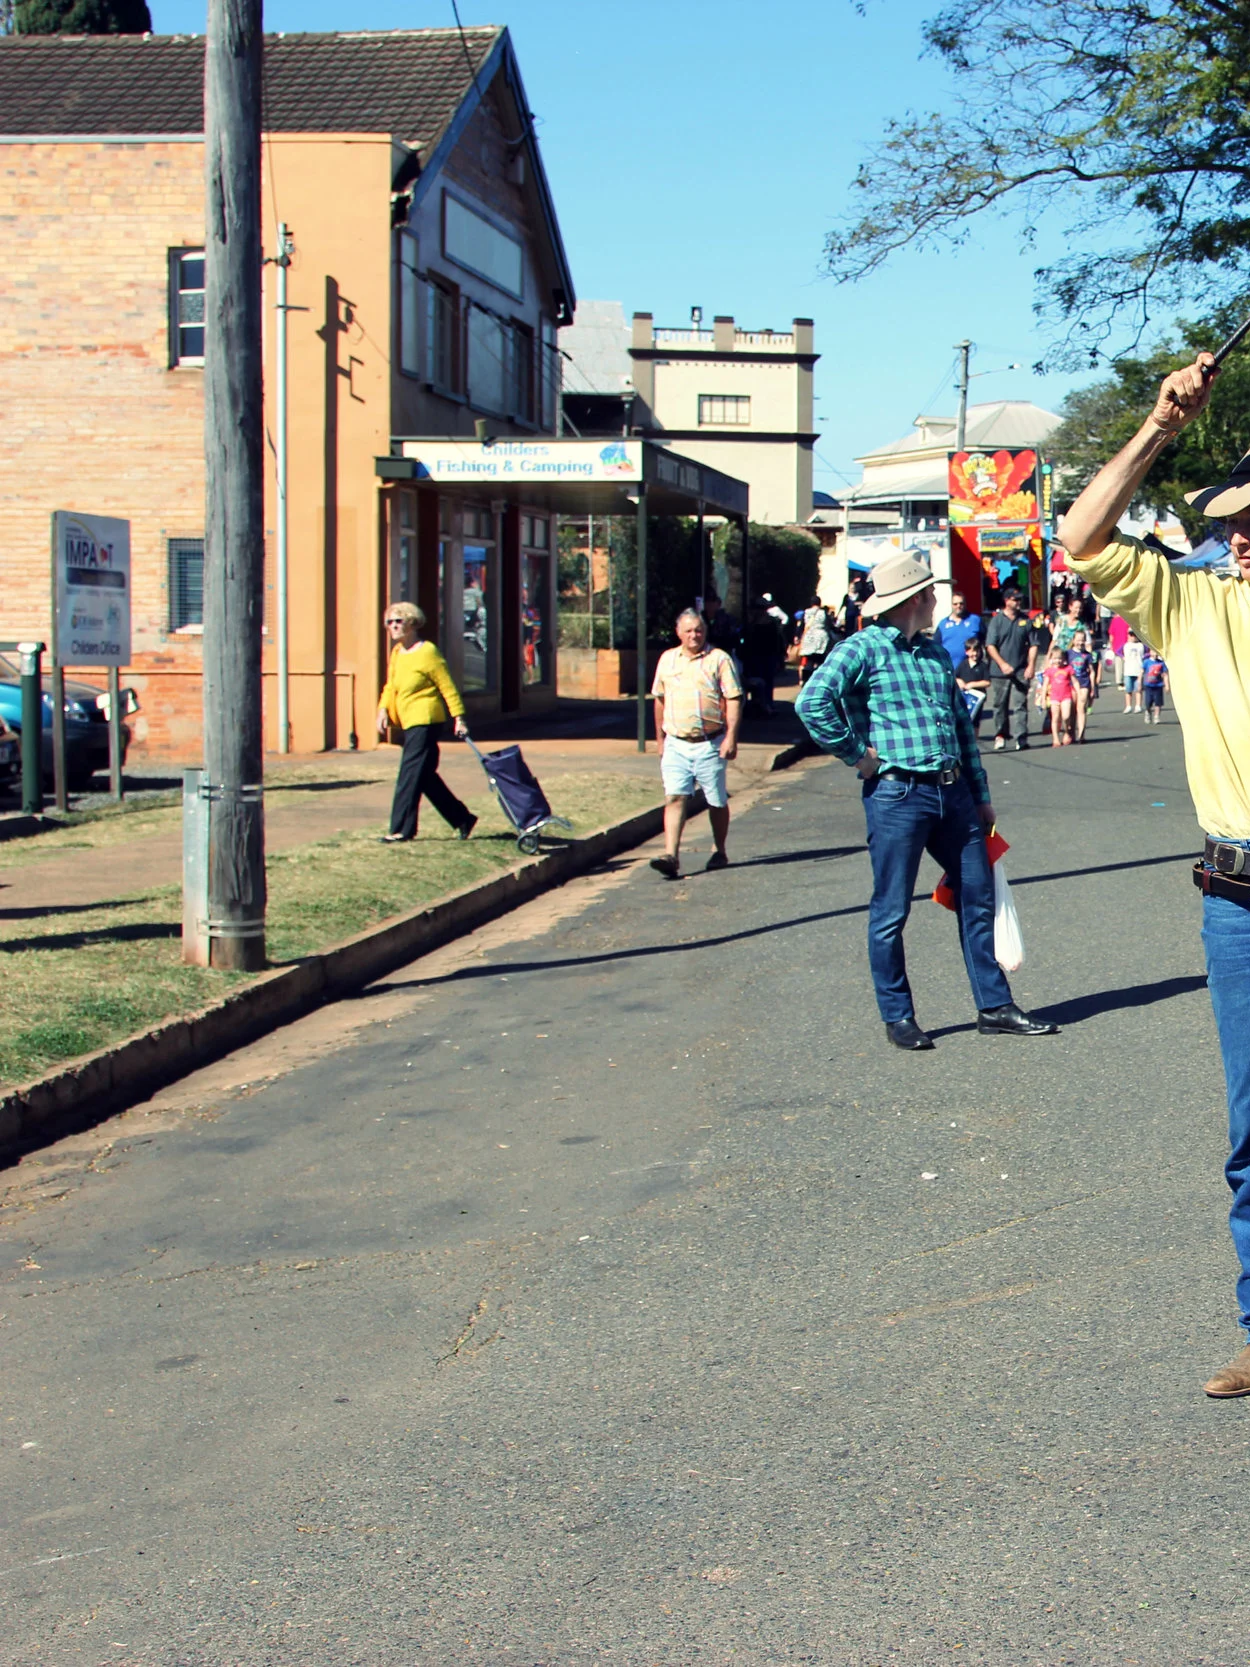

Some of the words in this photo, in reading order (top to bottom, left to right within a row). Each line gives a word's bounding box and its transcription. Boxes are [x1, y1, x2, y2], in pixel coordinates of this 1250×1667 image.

[481, 443, 549, 456] Childers
[436, 460, 497, 477] Fishing
[503, 460, 514, 472] &
[520, 460, 593, 476] Camping
